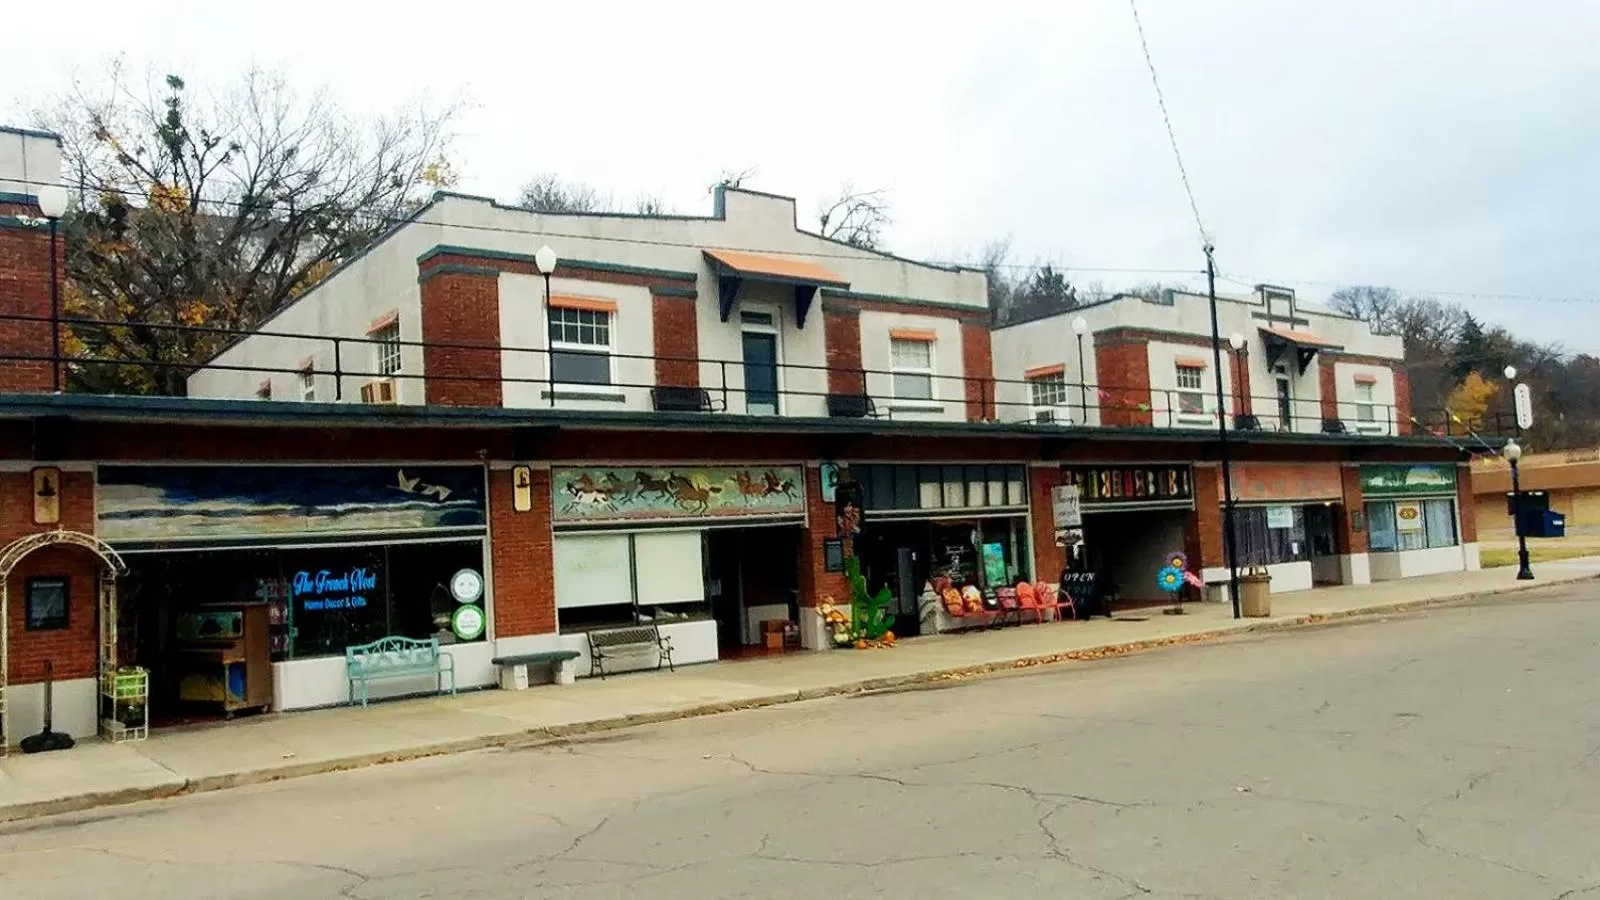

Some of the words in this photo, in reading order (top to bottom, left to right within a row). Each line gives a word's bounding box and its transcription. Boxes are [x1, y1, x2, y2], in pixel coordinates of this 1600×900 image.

[293, 570, 314, 596] The
[315, 569, 349, 594] French
[350, 567, 376, 593] Nest
[1064, 572, 1095, 582] OPEN
[304, 599, 324, 610] Home
[325, 598, 344, 609] Decor
